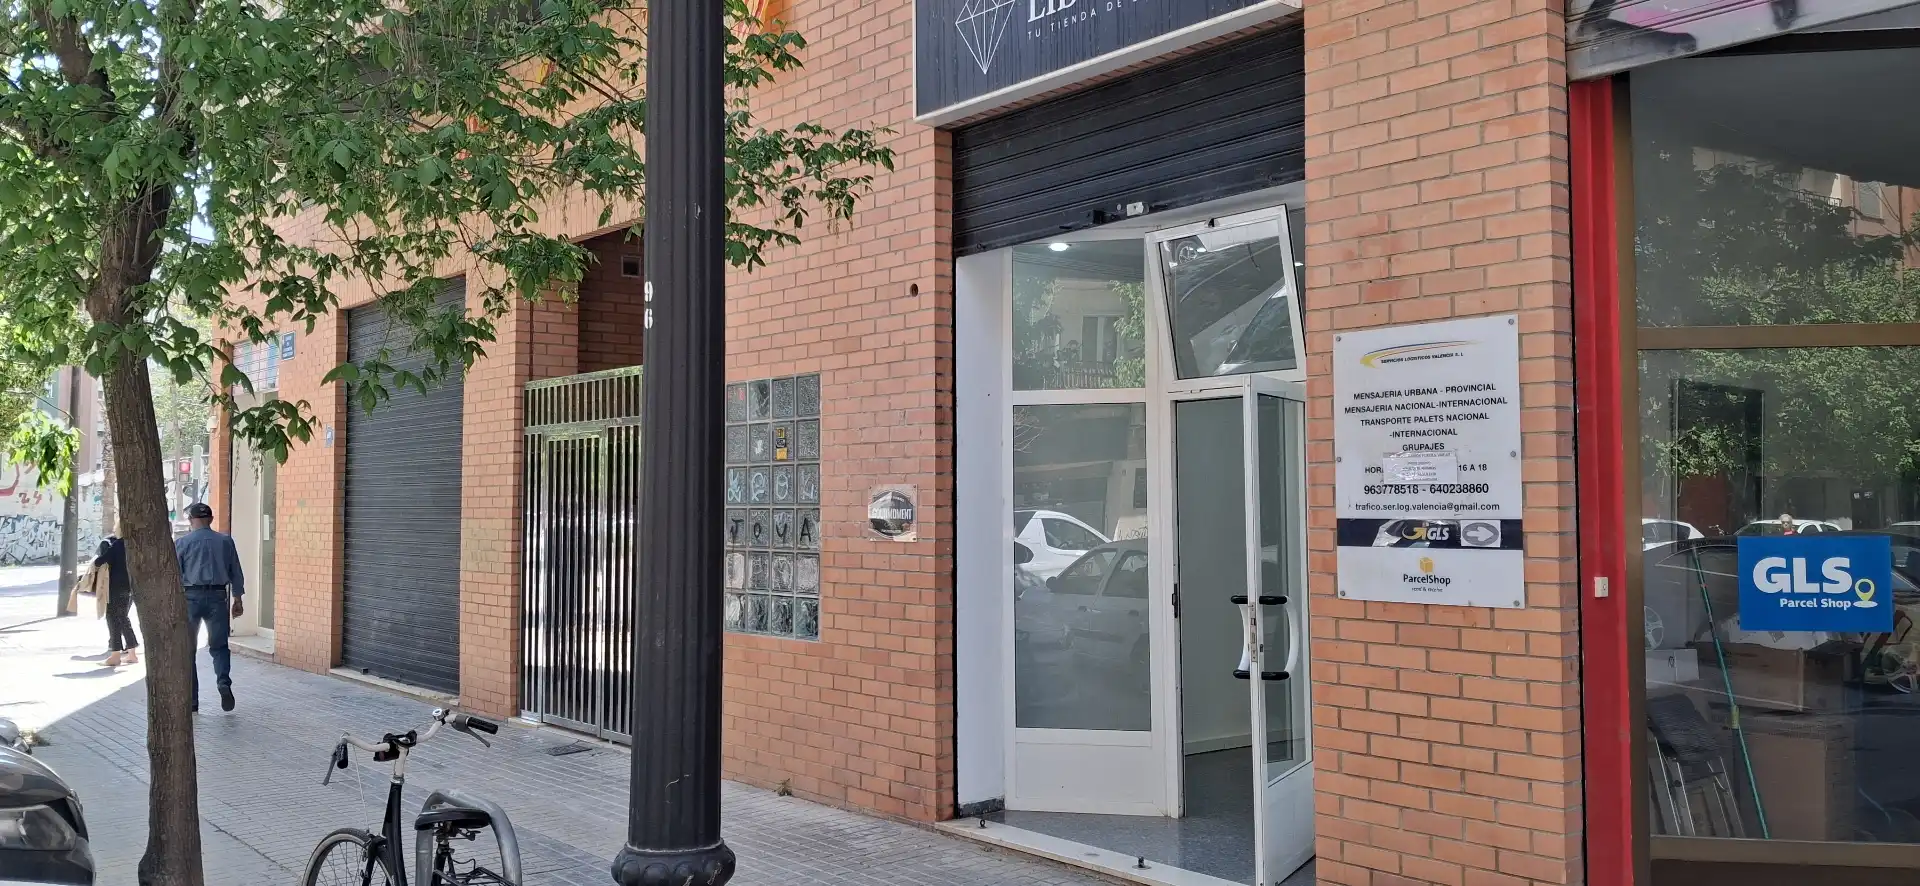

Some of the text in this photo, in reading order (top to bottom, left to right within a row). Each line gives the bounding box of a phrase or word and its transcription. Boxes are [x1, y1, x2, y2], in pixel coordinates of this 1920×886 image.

[1027, 0, 1122, 40] TU TIENDA DE
[1353, 390, 1402, 400] MENSAJERIA
[1404, 387, 1438, 396] URBANA
[1445, 383, 1497, 394] PROVINCIAL
[1344, 397, 1508, 414] MENSAJERIA NACIONAL-INTERNACIONAL
[1360, 412, 1490, 426] TRANSPORTE PALETS NACIONAL
[1389, 428, 1458, 438] -INTERNACIONAL
[1402, 442, 1445, 452] GRUPAJES
[1458, 464, 1468, 472] 16
[1469, 463, 1476, 472] A
[1478, 463, 1488, 472] 18
[1363, 484, 1419, 495] 963778518
[1429, 483, 1489, 494] 640238860
[1355, 502, 1500, 512] trafico.ser.log.valencia@gmail.com
[1426, 527, 1450, 541] GLS
[1403, 573, 1451, 587] ParcelShop
[1753, 556, 1853, 594] GLS
[1779, 598, 1852, 611] Parcel Shop
